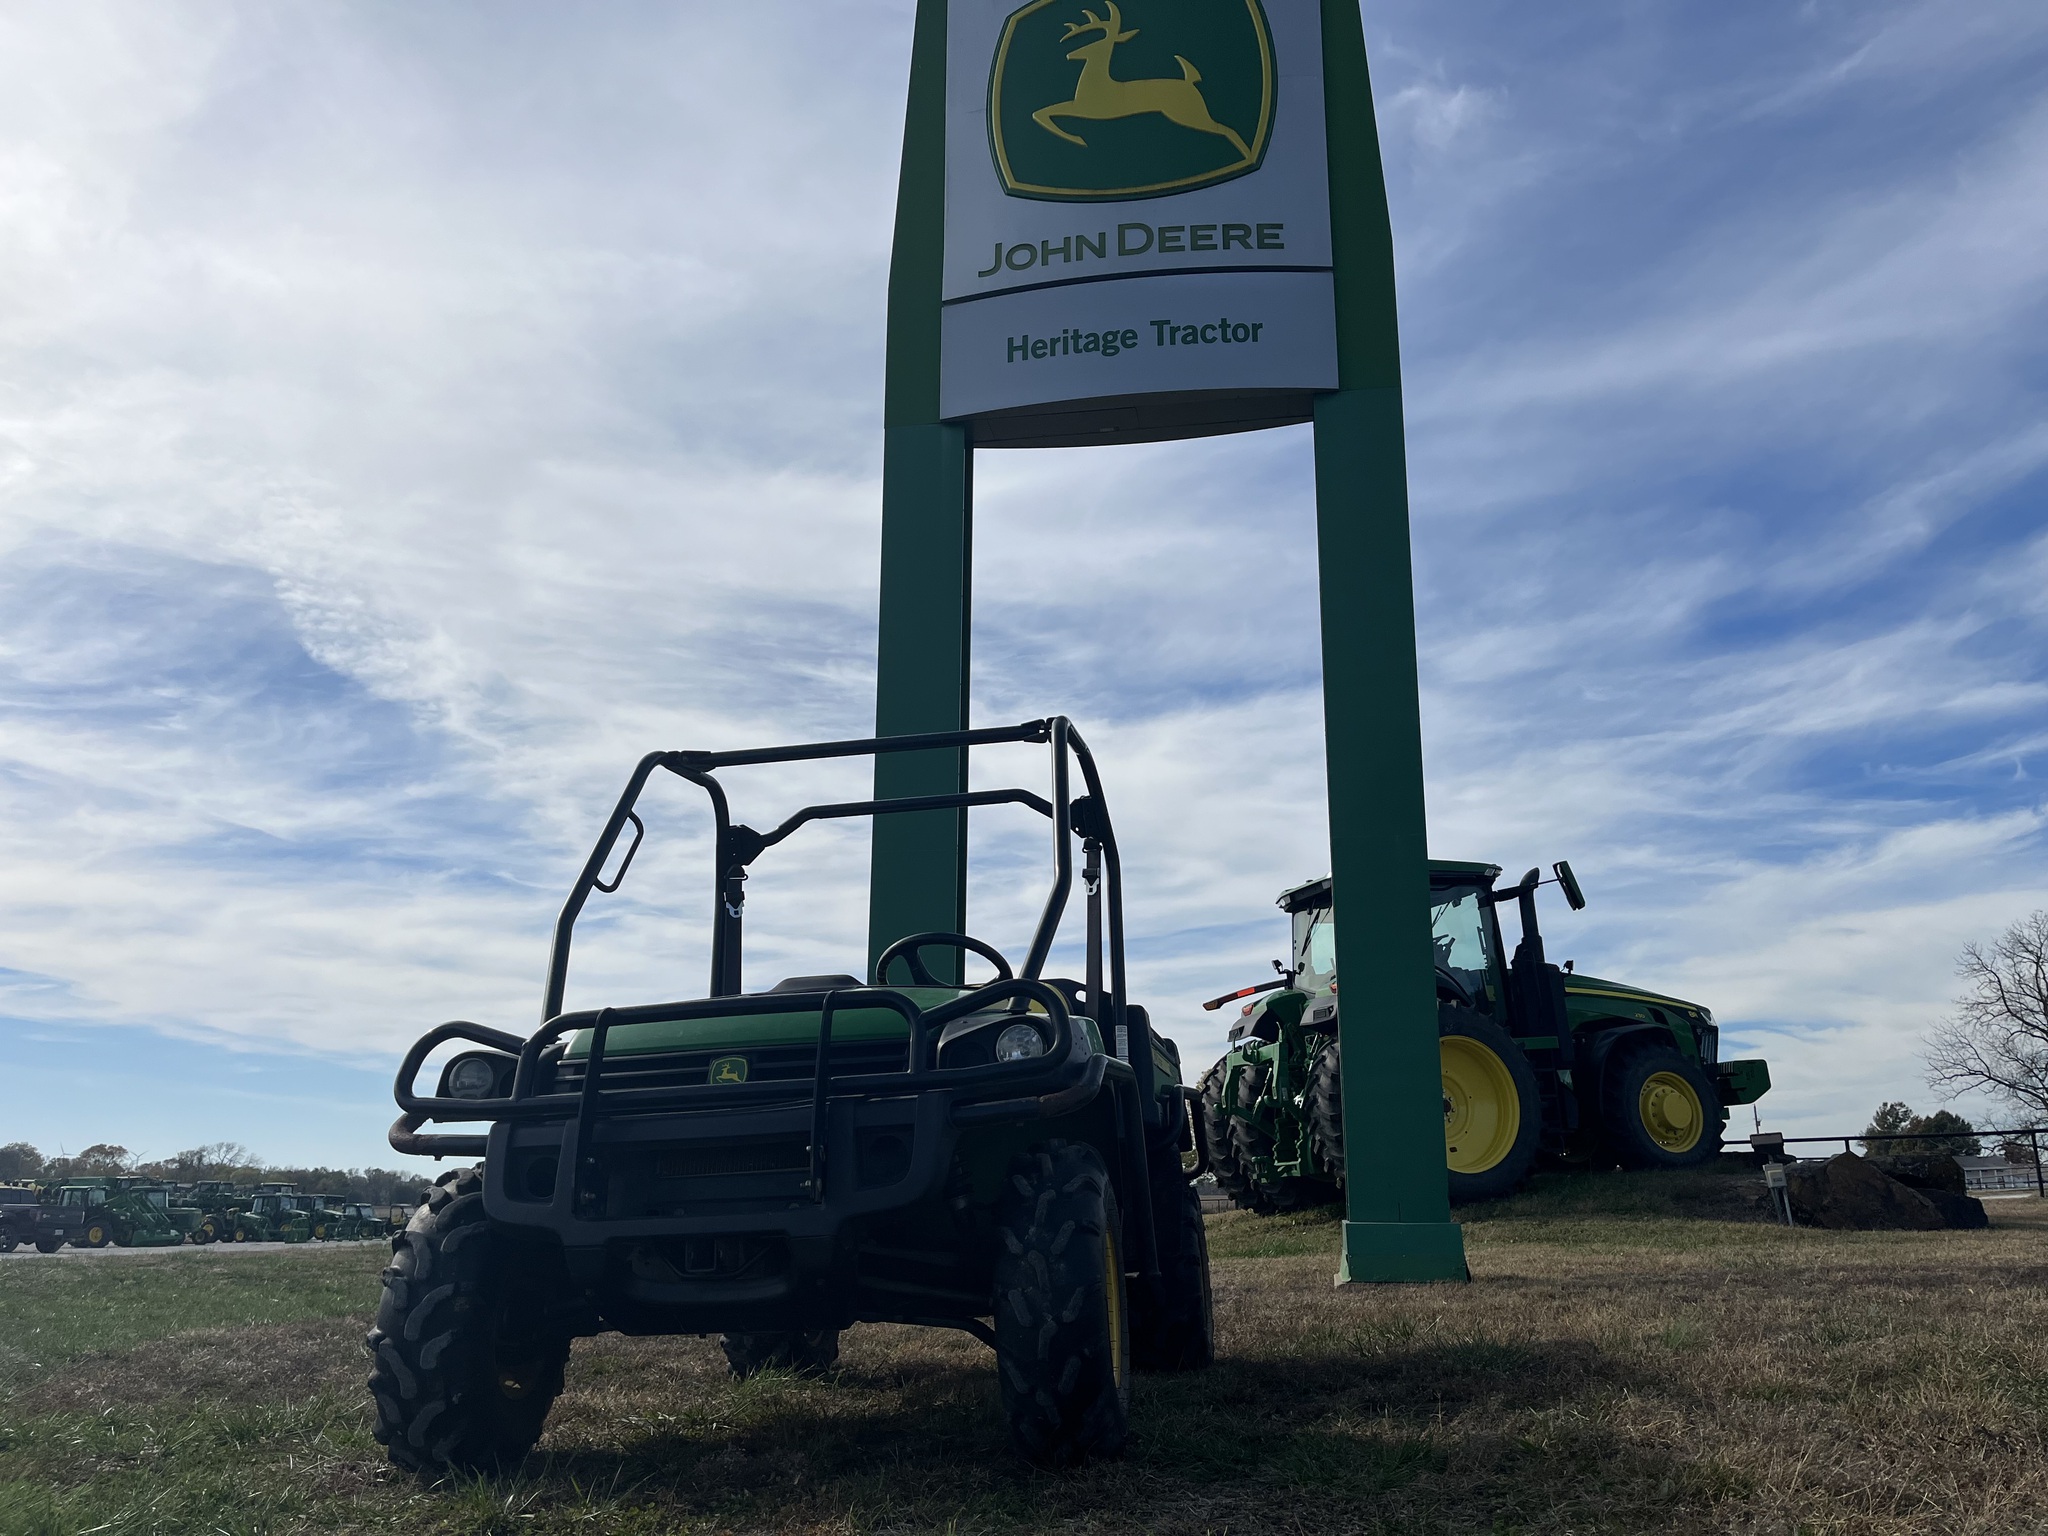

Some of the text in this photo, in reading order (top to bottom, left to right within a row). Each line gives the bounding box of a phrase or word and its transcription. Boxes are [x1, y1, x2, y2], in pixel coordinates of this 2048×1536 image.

[977, 223, 1285, 278] JOHN DEERE
[1007, 317, 1264, 363] Heritage Tractor
